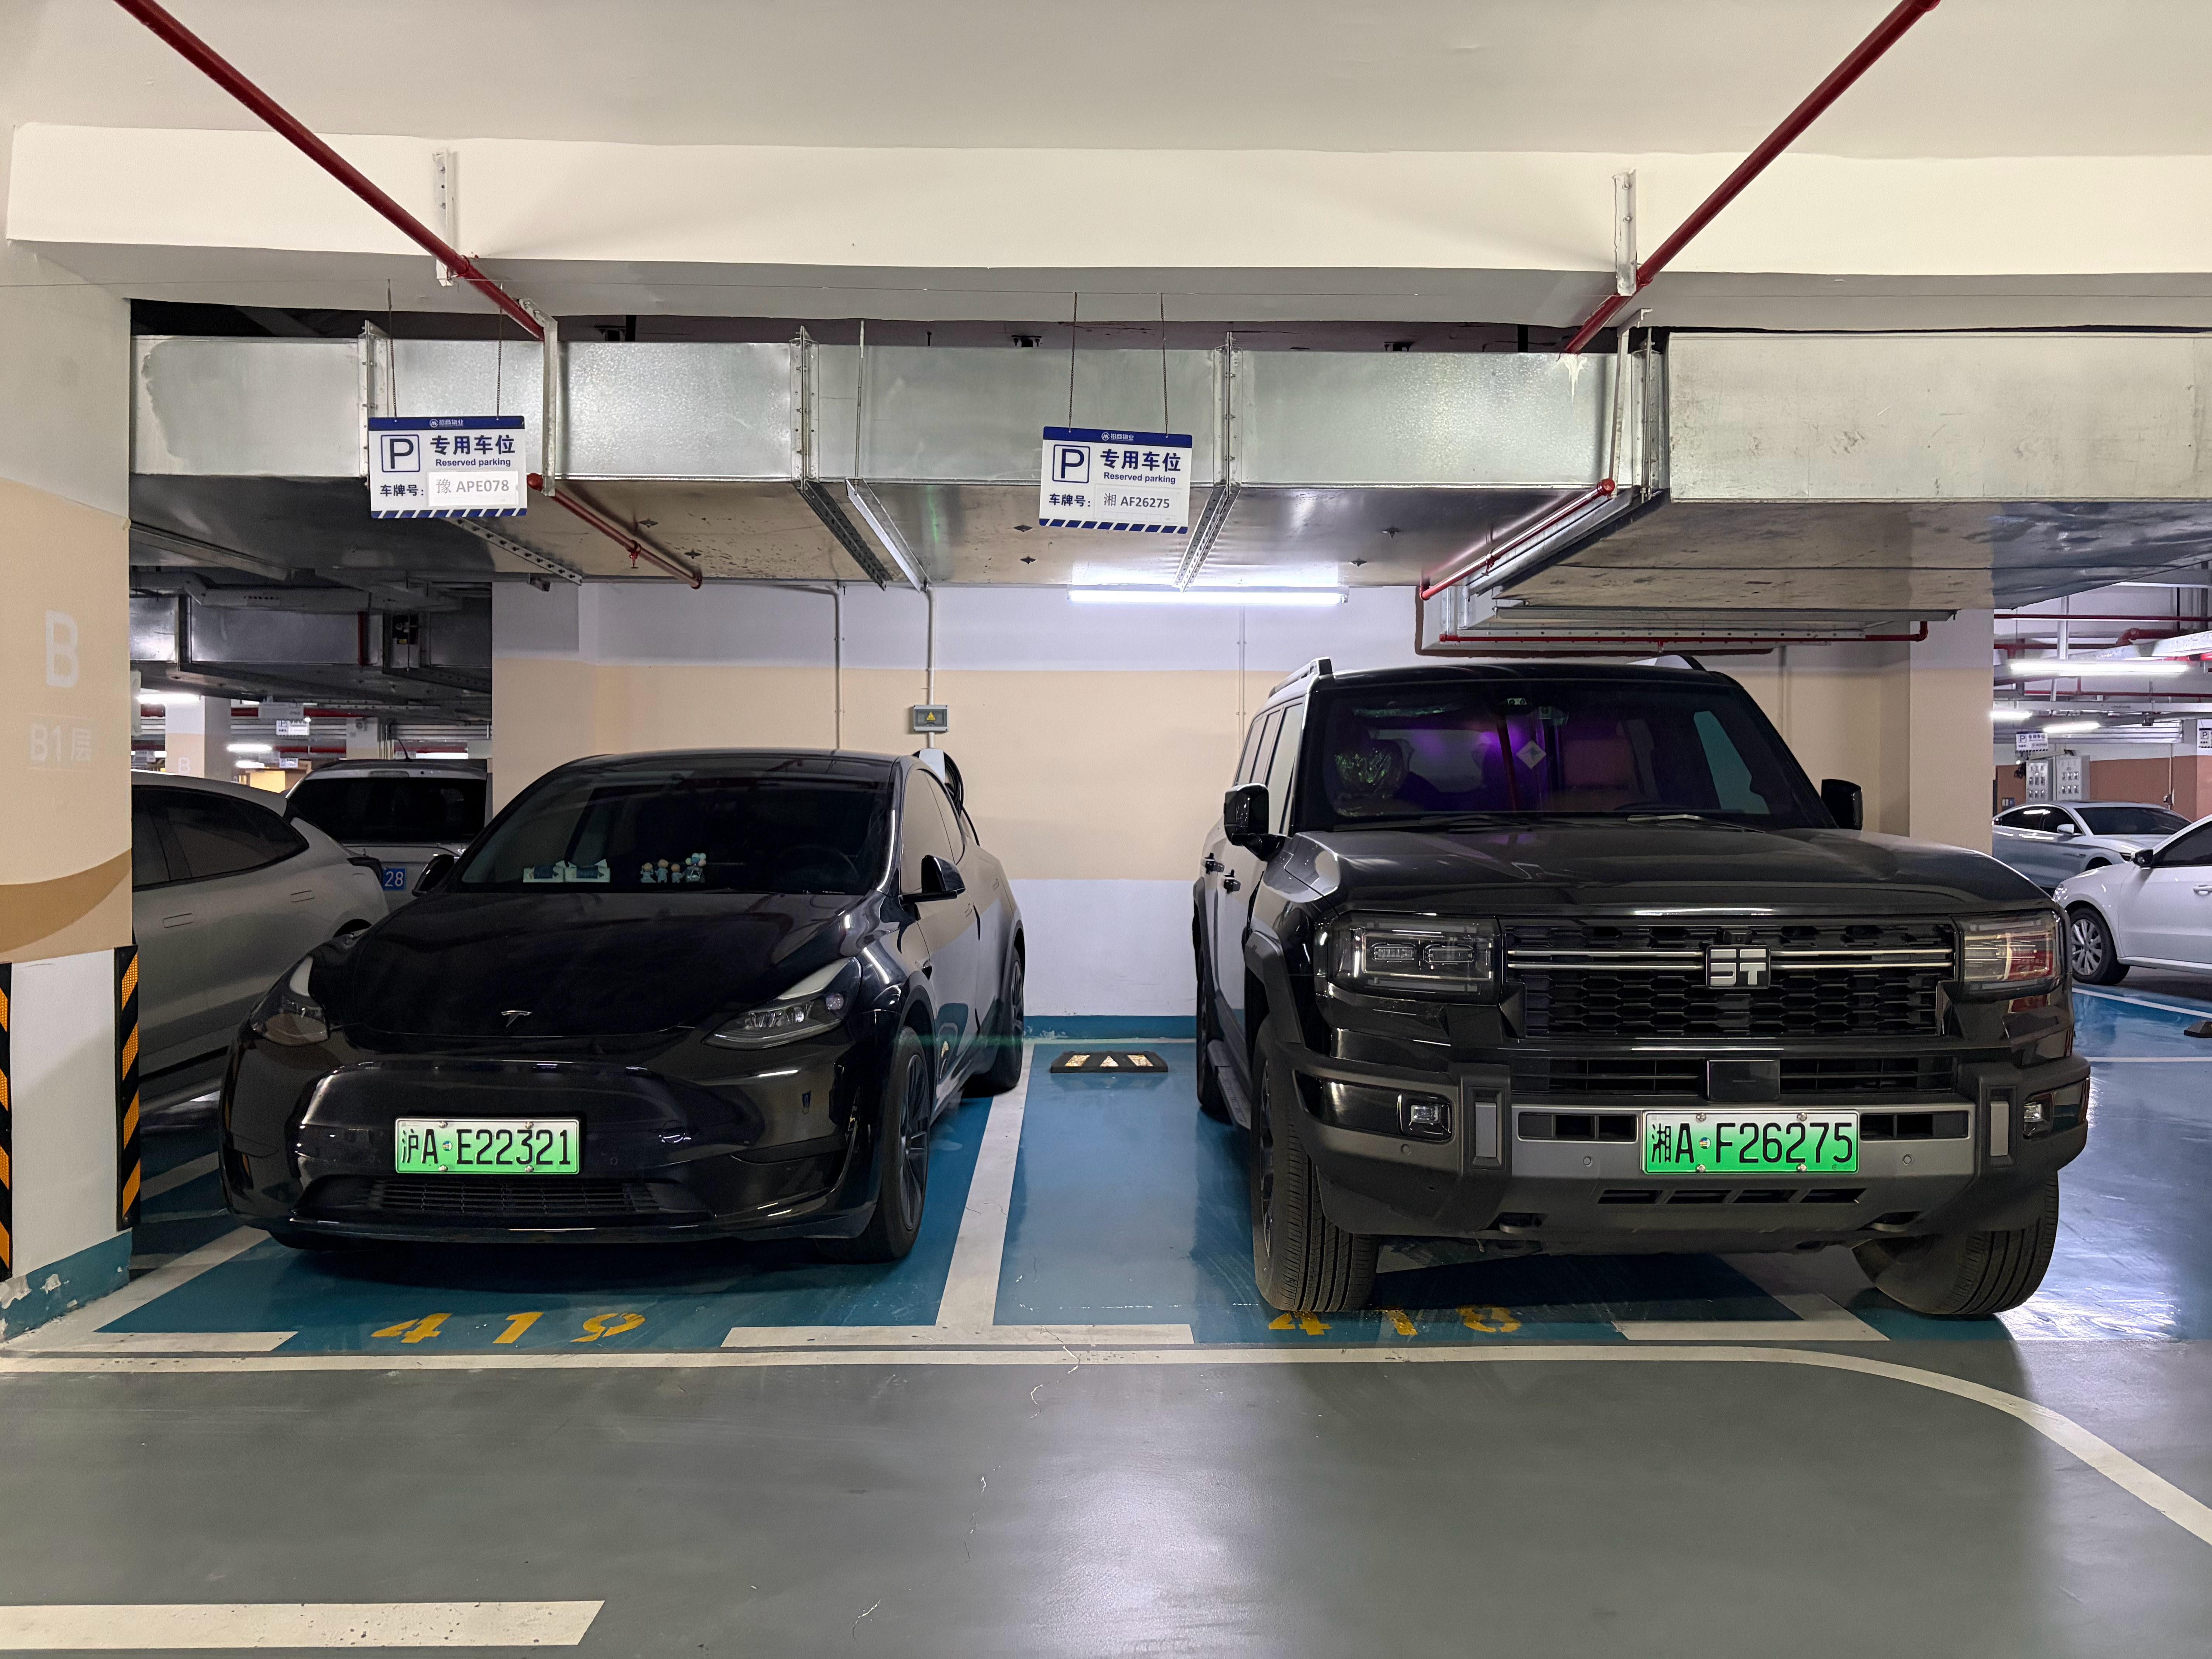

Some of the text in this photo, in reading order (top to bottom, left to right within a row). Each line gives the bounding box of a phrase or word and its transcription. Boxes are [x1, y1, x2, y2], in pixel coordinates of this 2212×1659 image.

[390, 438, 414, 469] P
[430, 435, 515, 455] 专用车位
[479, 458, 511, 467] parking
[1061, 448, 1084, 478] P
[1100, 449, 1181, 472] 专用车位
[456, 480, 510, 492] APE078
[1104, 472, 1176, 484] Reserved parking
[1120, 497, 1170, 508] AF26275
[45, 609, 79, 688] B
